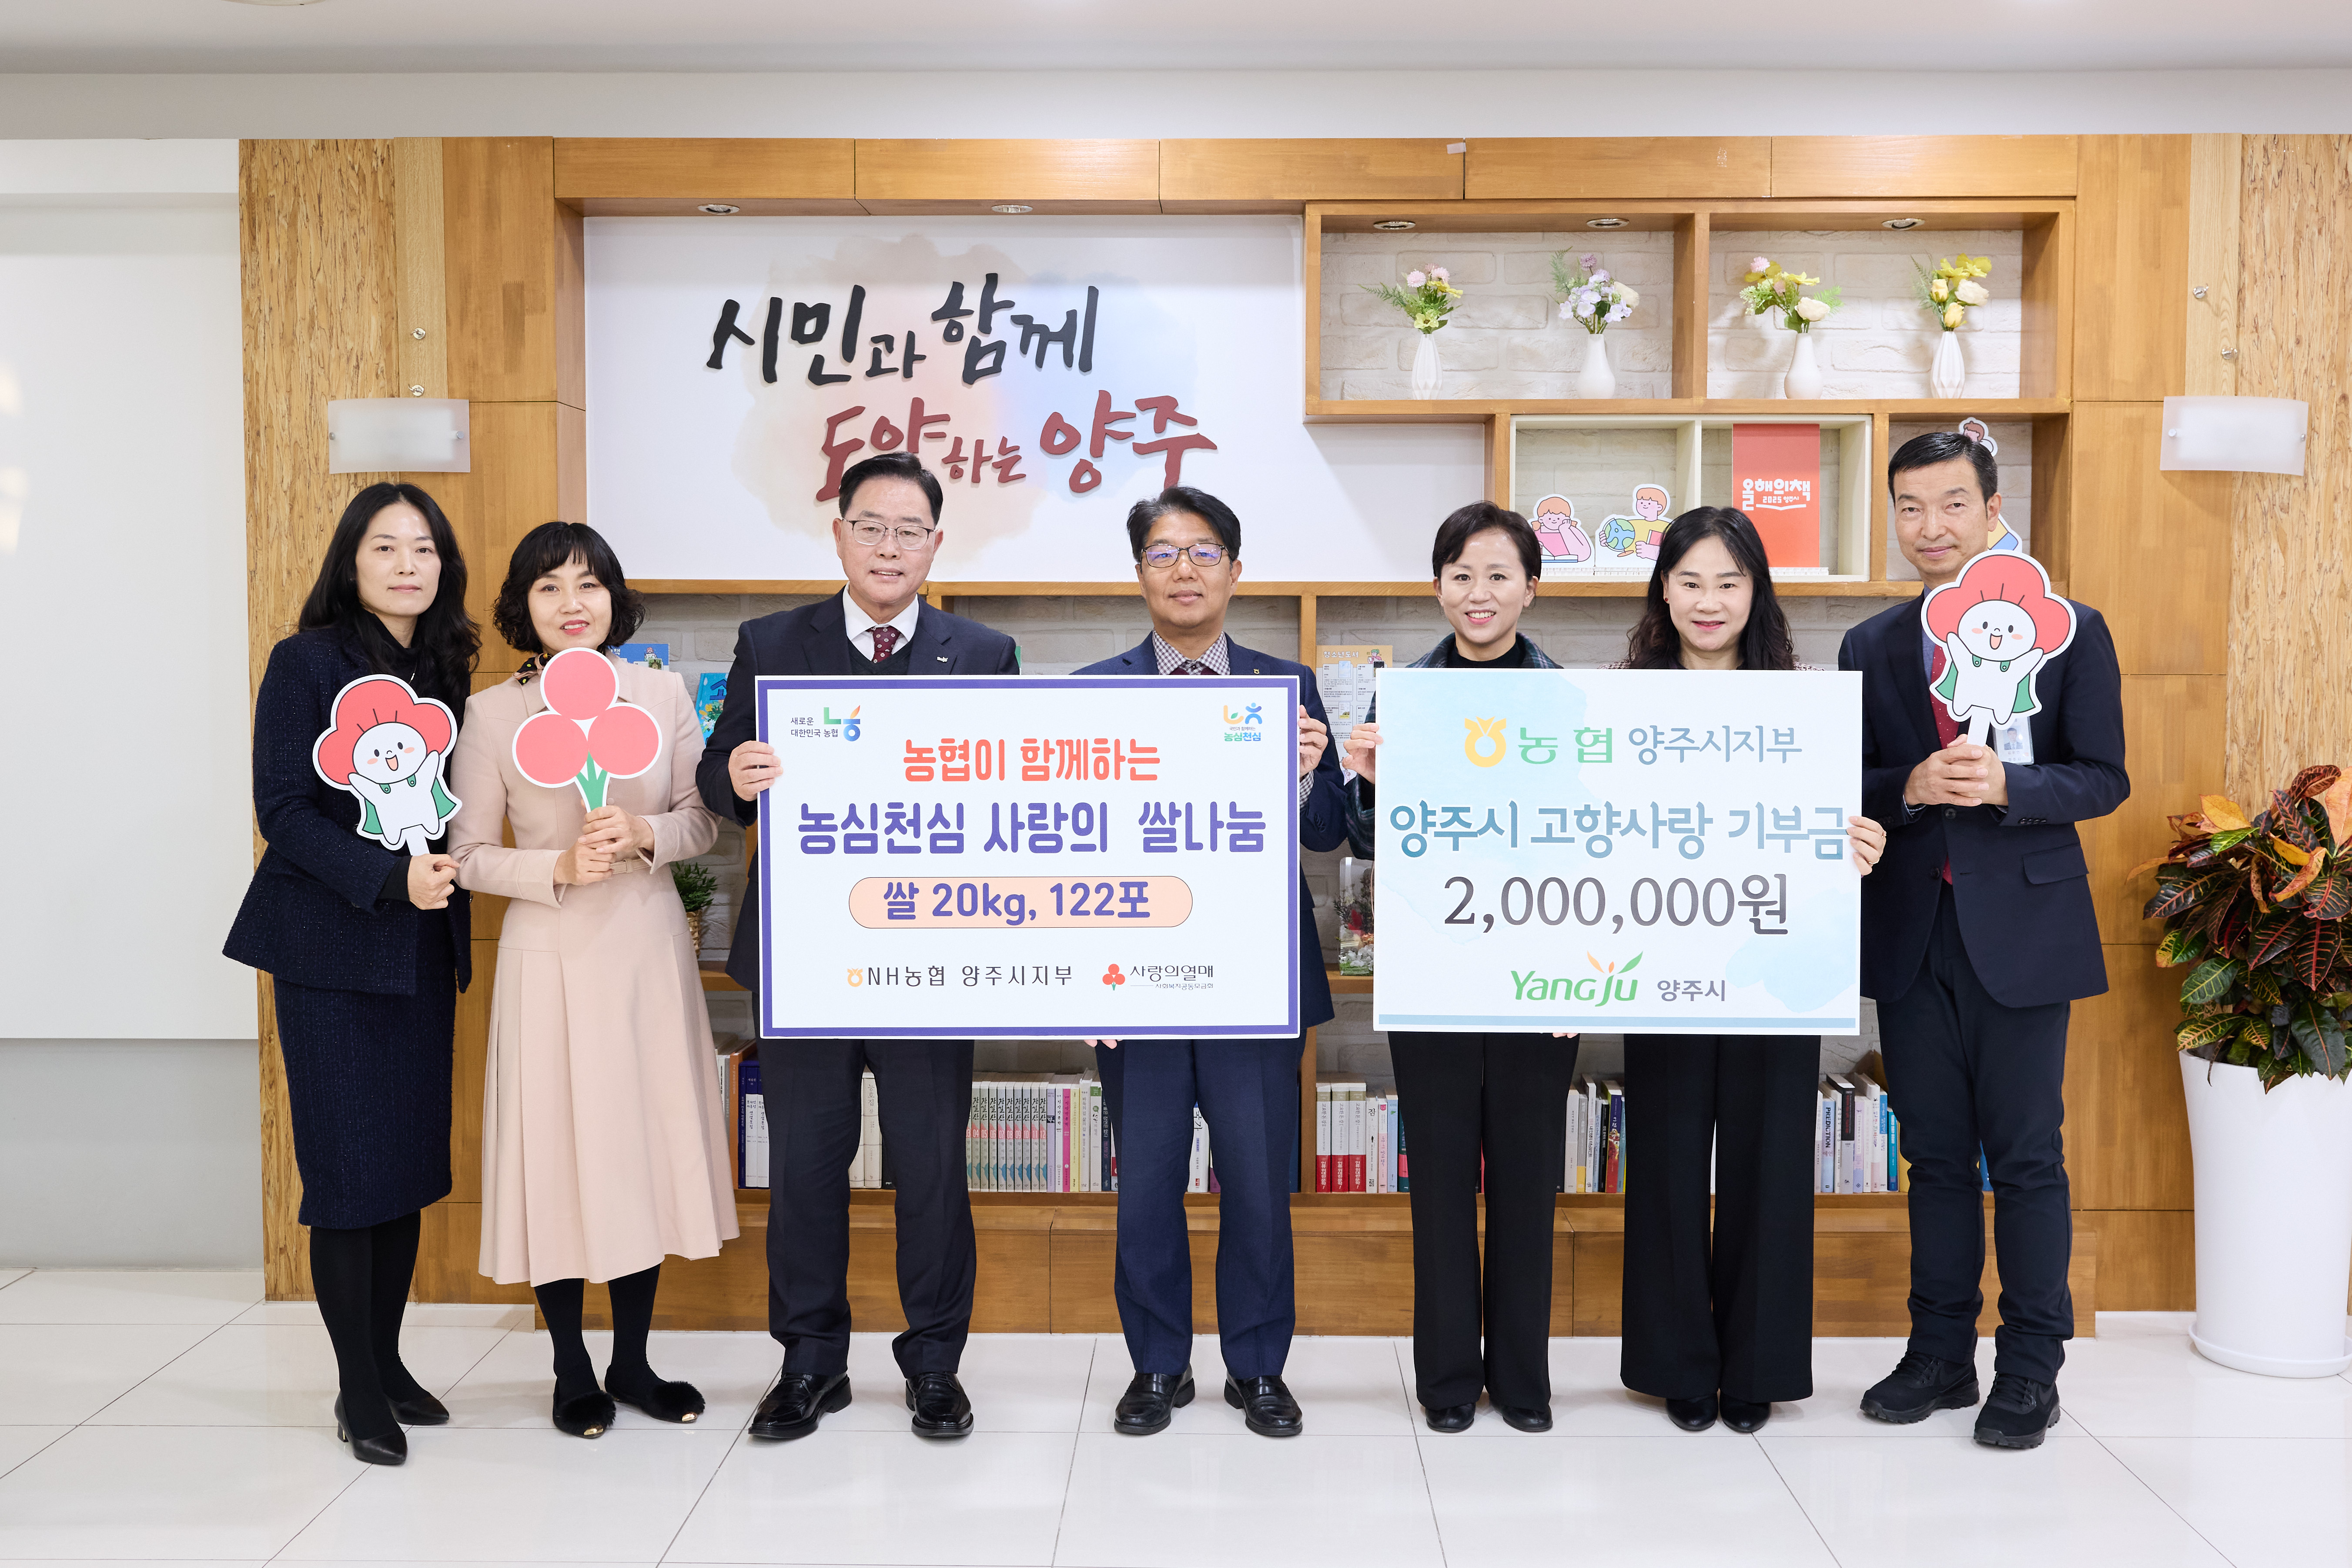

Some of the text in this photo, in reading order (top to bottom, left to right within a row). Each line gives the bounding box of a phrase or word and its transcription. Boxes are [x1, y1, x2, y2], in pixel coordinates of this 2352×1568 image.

[706, 273, 1099, 387] 시민과 함께
[1040, 390, 1218, 488] 양주
[1742, 478, 1810, 511] 올해의책
[791, 717, 814, 725] 새로운
[791, 729, 838, 737] 대한민국 농협
[1224, 732, 1261, 742] 농심천심
[903, 738, 1161, 782] 농협이 함께하는
[1518, 725, 1803, 766] 농협 양주시지부
[798, 801, 1266, 854] 농심천심 사랑의 쌀나눔
[1390, 799, 1849, 860] 양주시 고향사랑 기부금
[883, 881, 1151, 926] 쌀 20kg, 122포
[1444, 873, 1788, 935] 2,000,000원
[868, 966, 1072, 986] NH농협 양주시지부
[1130, 965, 1213, 982] 사랑의열매
[1657, 980, 1725, 1001] 양주시
